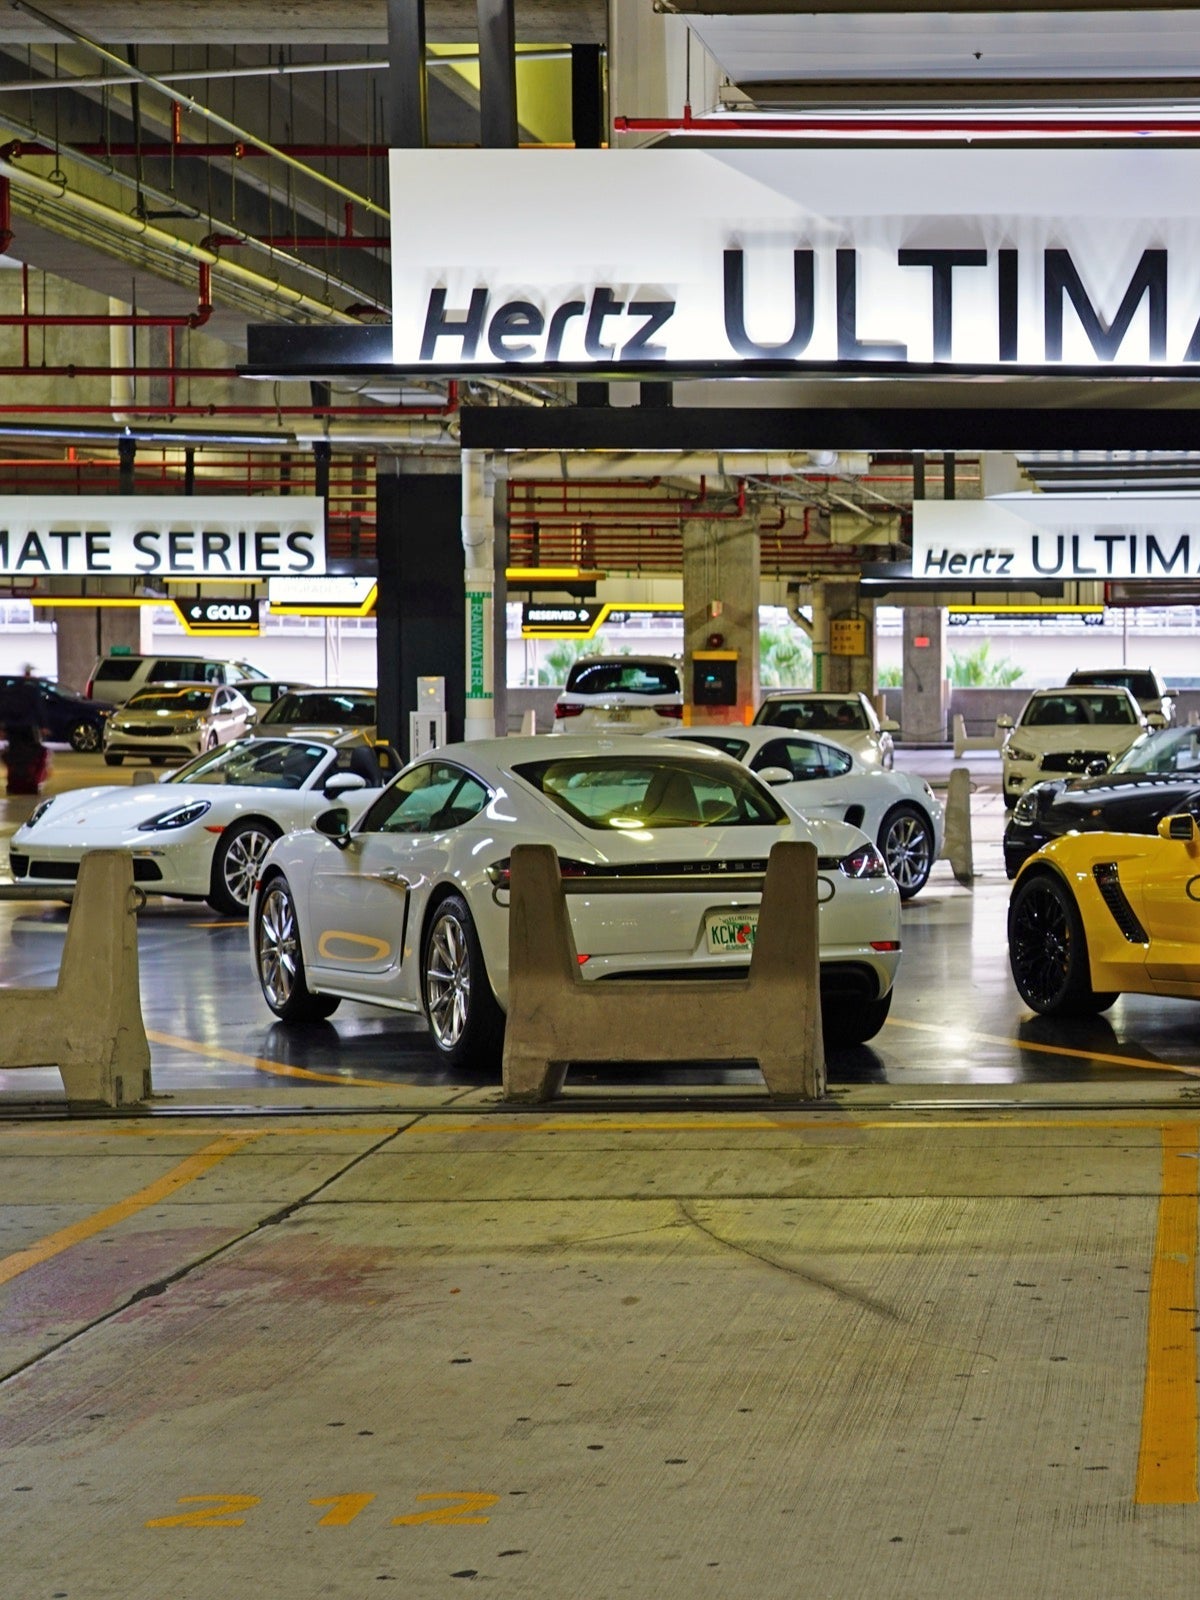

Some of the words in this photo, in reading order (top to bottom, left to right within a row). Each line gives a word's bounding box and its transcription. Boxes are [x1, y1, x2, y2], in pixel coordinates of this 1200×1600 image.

[418, 286, 677, 362] Hertz
[132, 530, 315, 572] SERIES
[923, 547, 1014, 575] Hertz
[206, 604, 252, 621] GOLD
[528, 609, 577, 621] RESERVED
[471, 603, 482, 686] RAINWATER
[711, 924, 736, 944] KCW
[145, 1492, 501, 1528] 212
